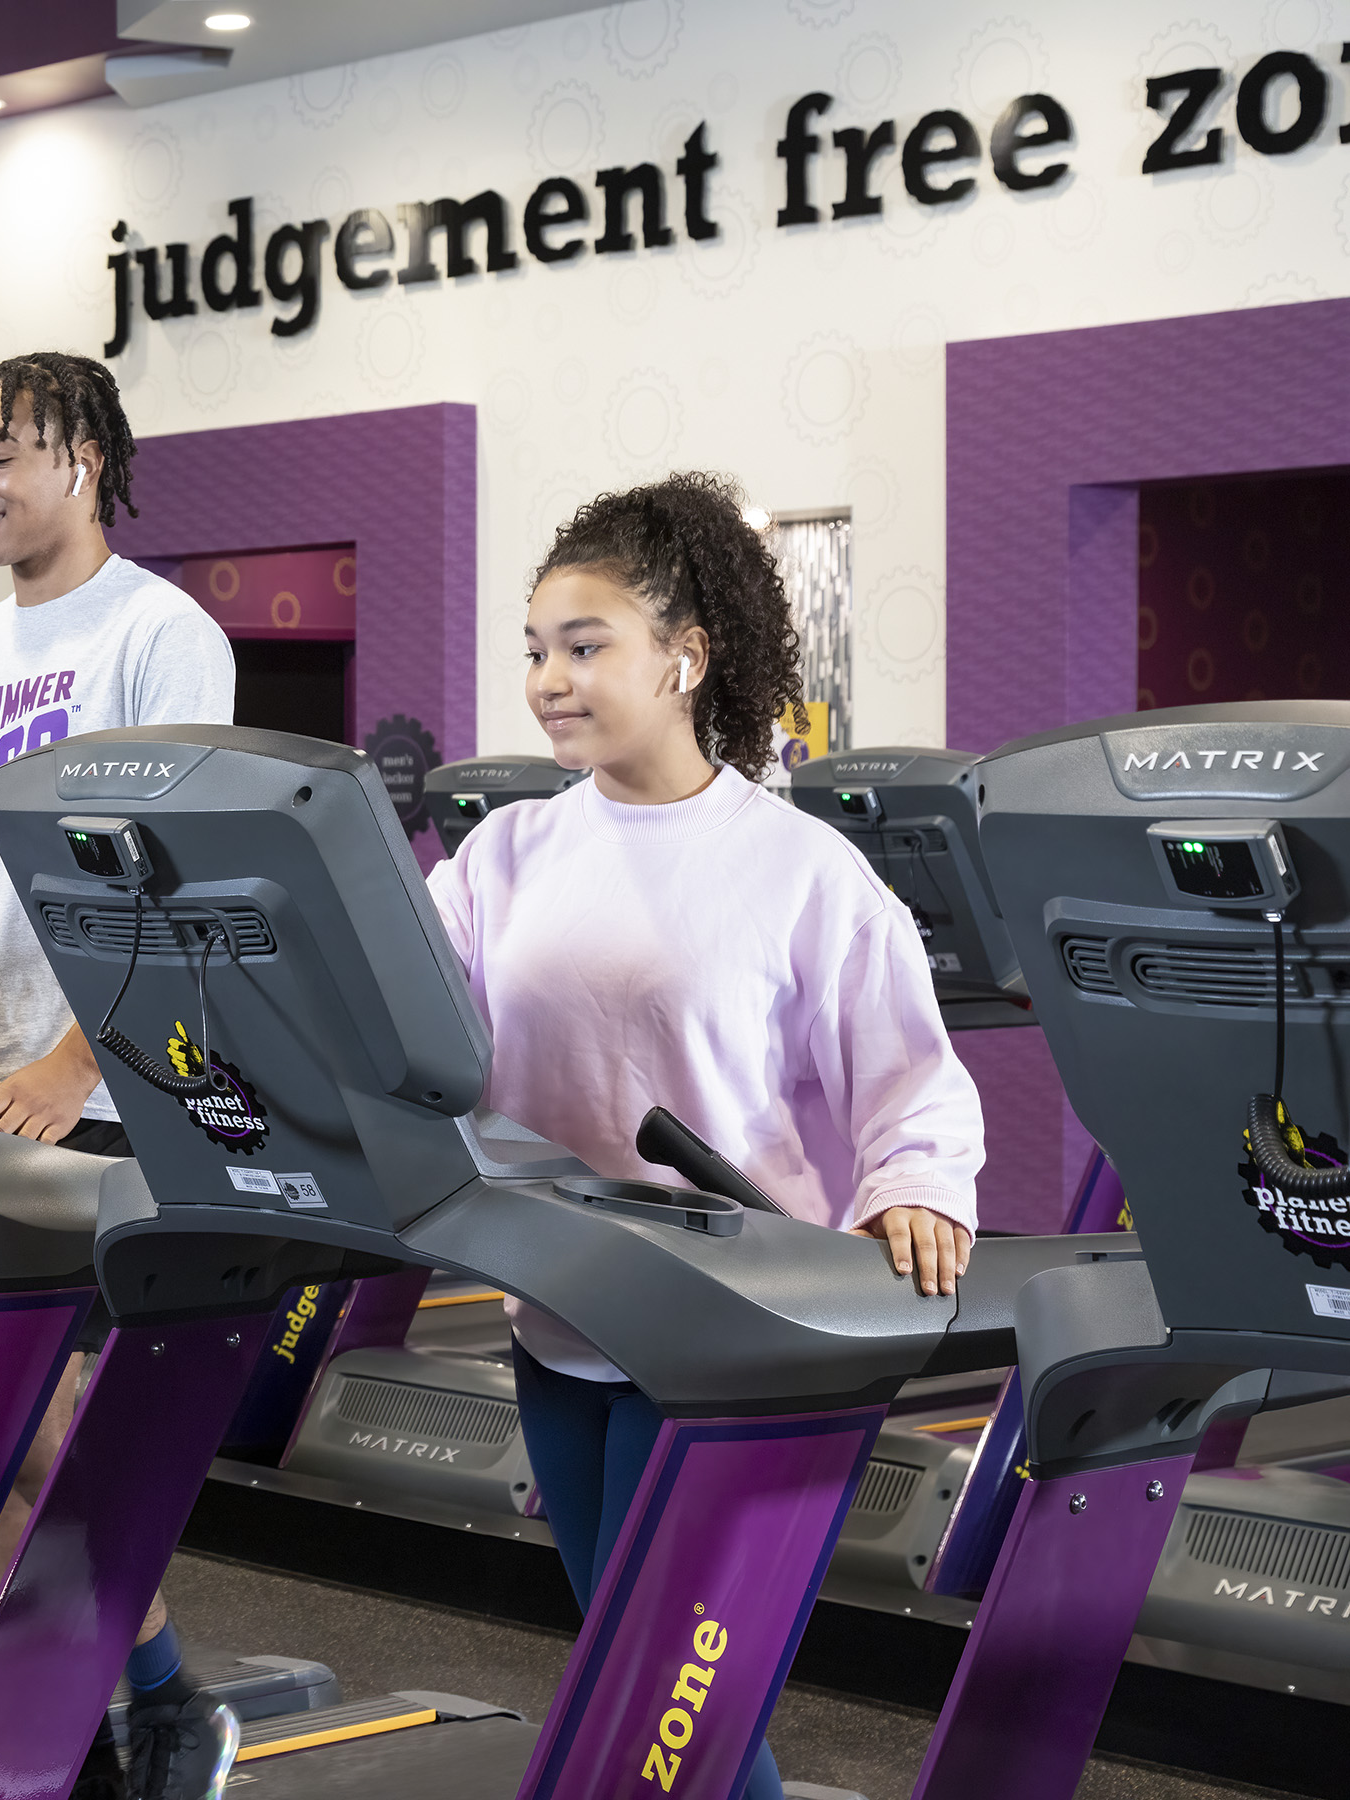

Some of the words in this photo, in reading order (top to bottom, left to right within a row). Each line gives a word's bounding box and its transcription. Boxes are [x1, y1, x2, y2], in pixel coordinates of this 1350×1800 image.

[104, 120, 718, 358] judgement
[777, 91, 1073, 227] free
[1141, 42, 1350, 174] zo
[382, 754, 414, 767] men's
[836, 762, 899, 773] MATRIX
[1123, 751, 1325, 771] MATRIX
[60, 762, 175, 778] MATRIX
[460, 769, 513, 779] MATRIX
[383, 773, 415, 785] locker
[390, 792, 413, 803] oom
[196, 1107, 266, 1131] fitness
[300, 1183, 317, 1198] 58
[1252, 1186, 1350, 1213] plane
[349, 1431, 461, 1463] MATRIX
